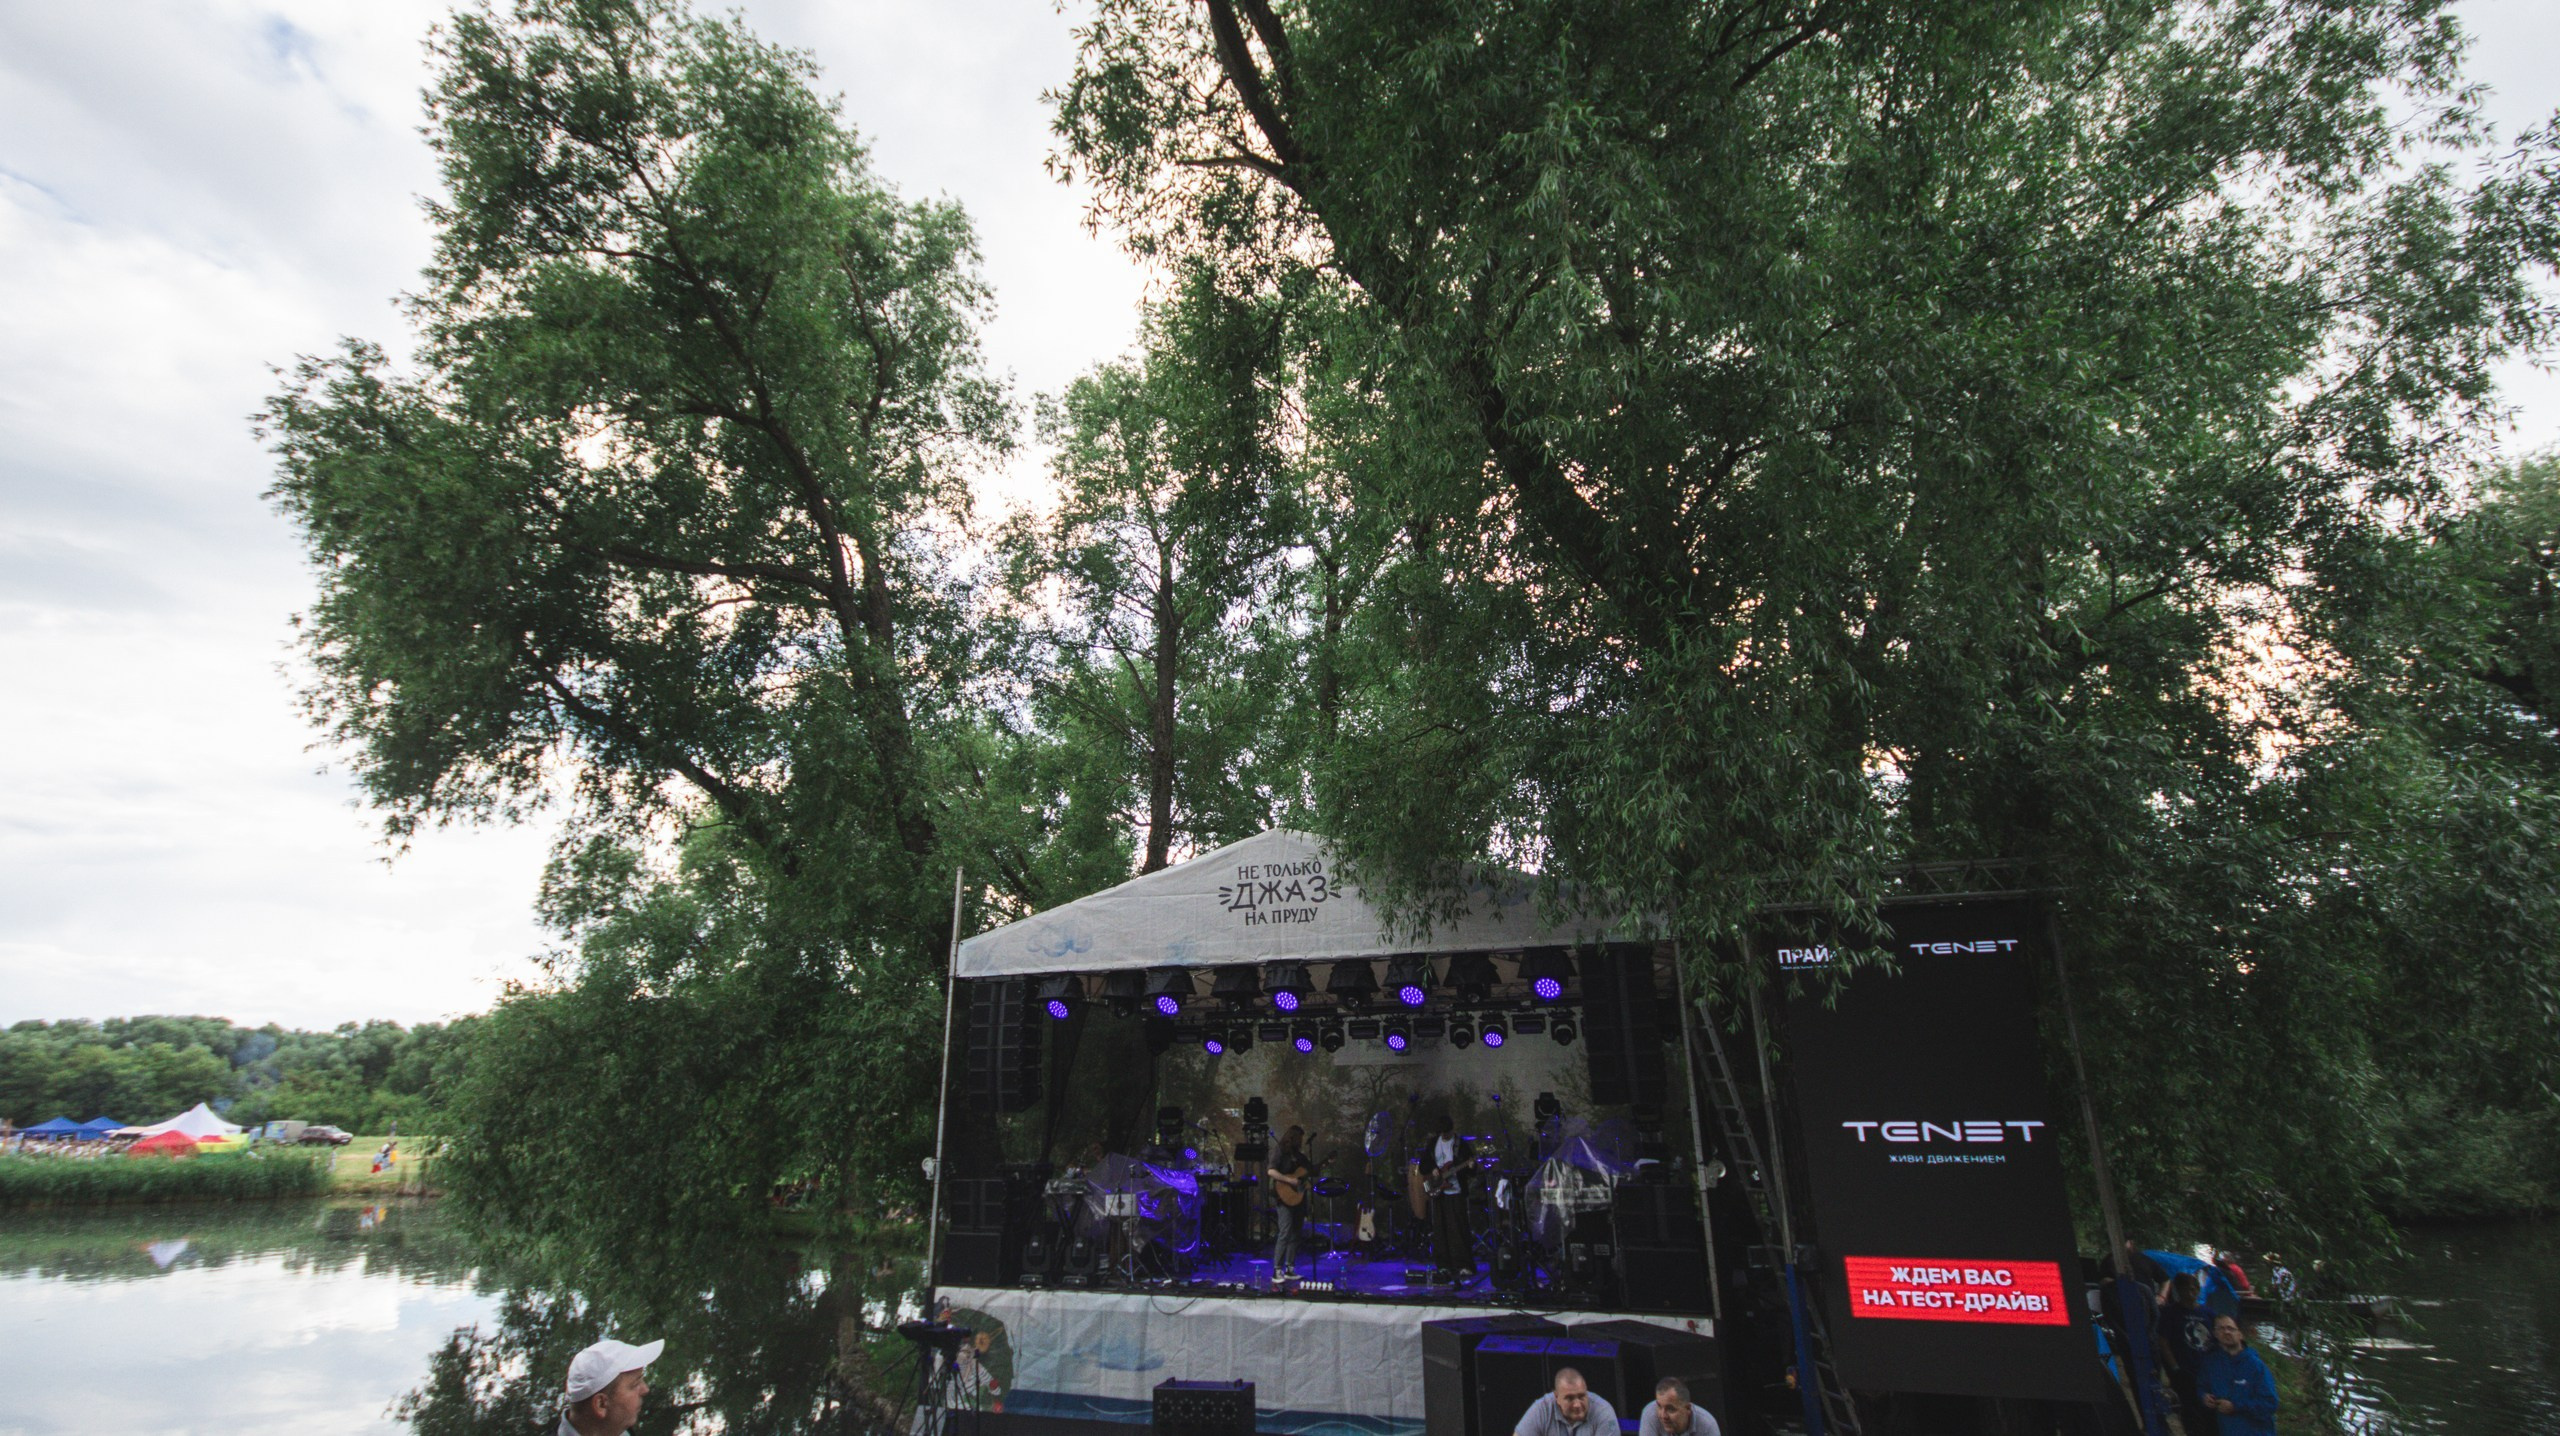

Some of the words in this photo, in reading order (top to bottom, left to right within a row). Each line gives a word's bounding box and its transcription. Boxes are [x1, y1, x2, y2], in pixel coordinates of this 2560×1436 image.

[1238, 865, 1259, 880] НЕ
[1264, 861, 1322, 878] ТОЛЬКО
[1228, 875, 1328, 912] ДЖАЗ
[1245, 911, 1268, 925] НА
[1272, 907, 1318, 924] ПРУДУ
[1909, 939, 2019, 955] TENET
[1842, 1121, 2045, 1142] TENET
[1889, 1154, 1923, 1163] ЖИВИ
[1927, 1154, 2006, 1164] ДВИЖЕНИЕМ
[1890, 1266, 1961, 1286] ЖДЕМ
[1964, 1269, 2012, 1286] ВАС
[1863, 1289, 1895, 1306] НА
[1897, 1290, 2049, 1312] ТЕСТ-ДРАЙВ!
